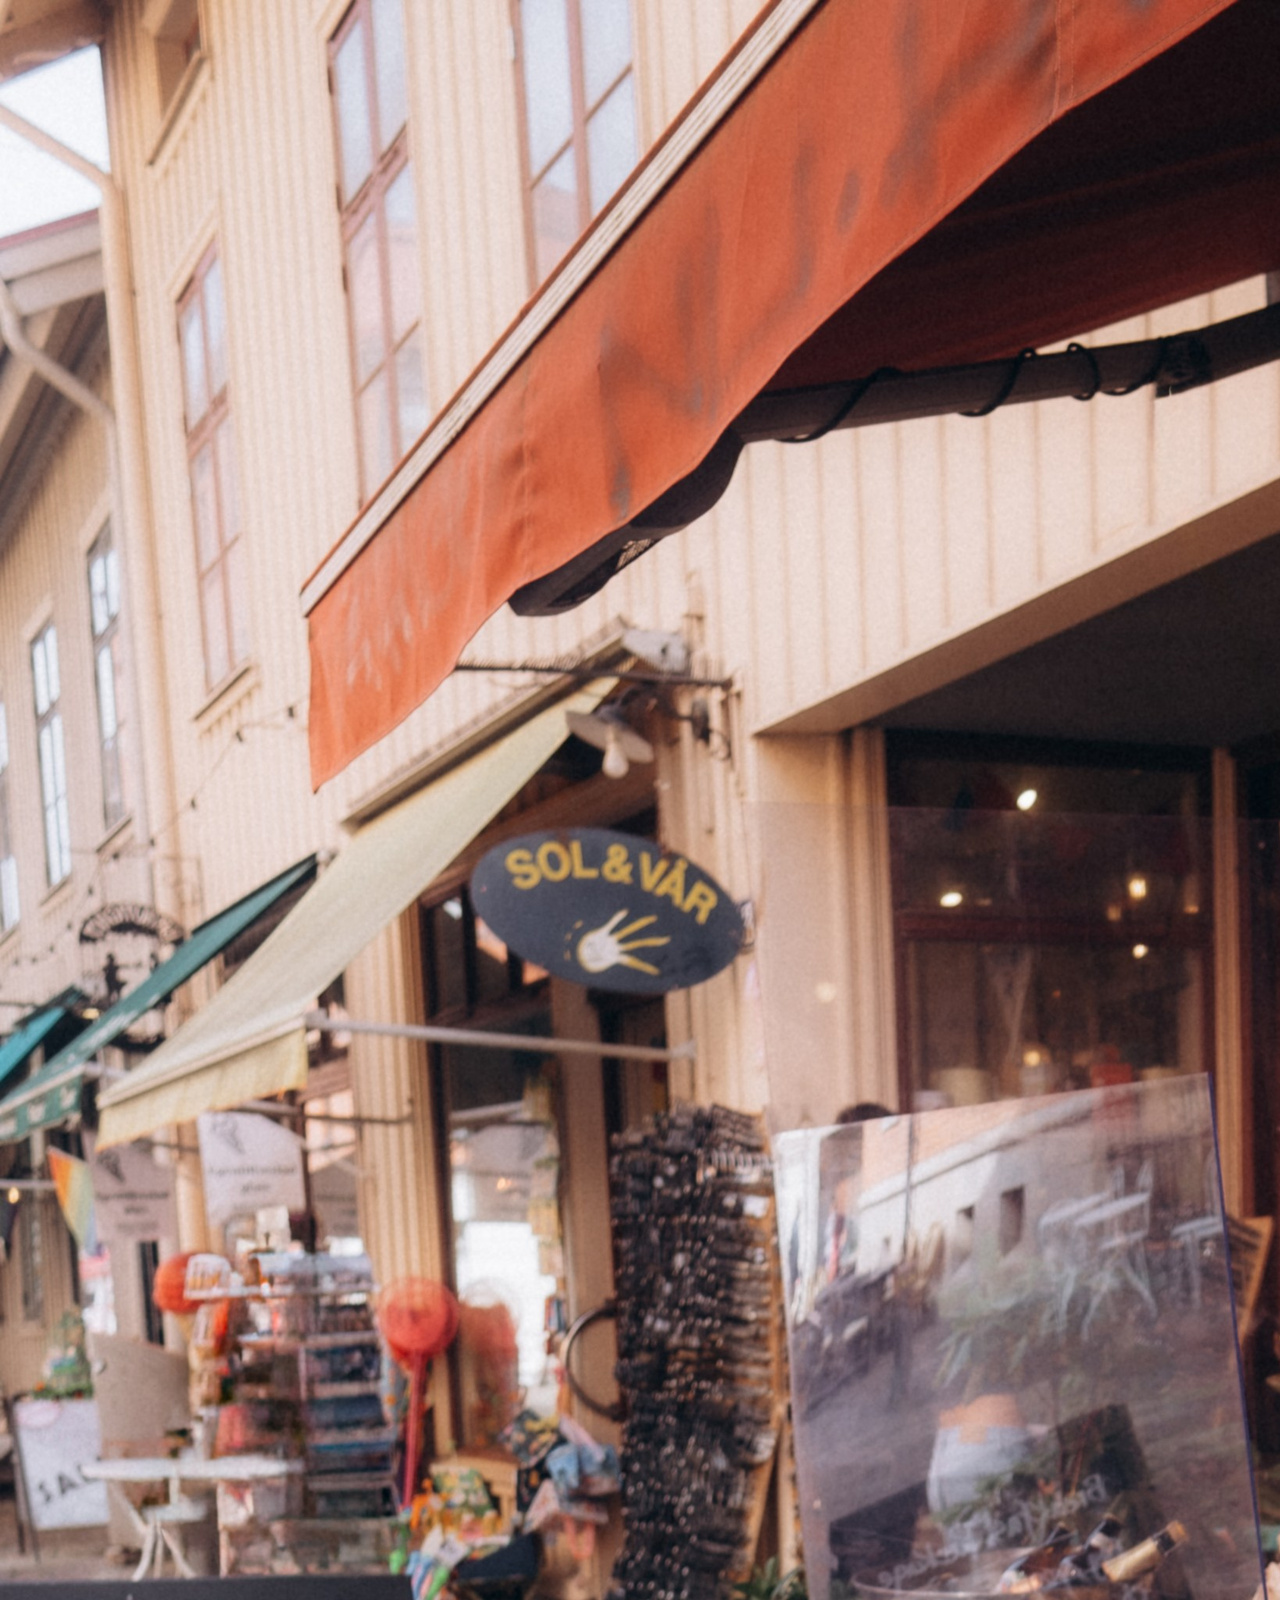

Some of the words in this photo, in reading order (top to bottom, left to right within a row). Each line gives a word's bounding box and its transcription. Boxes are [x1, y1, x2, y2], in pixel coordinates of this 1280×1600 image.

[504, 840, 600, 891] SOL
[601, 843, 634, 885] &
[639, 851, 719, 926] VÅR
